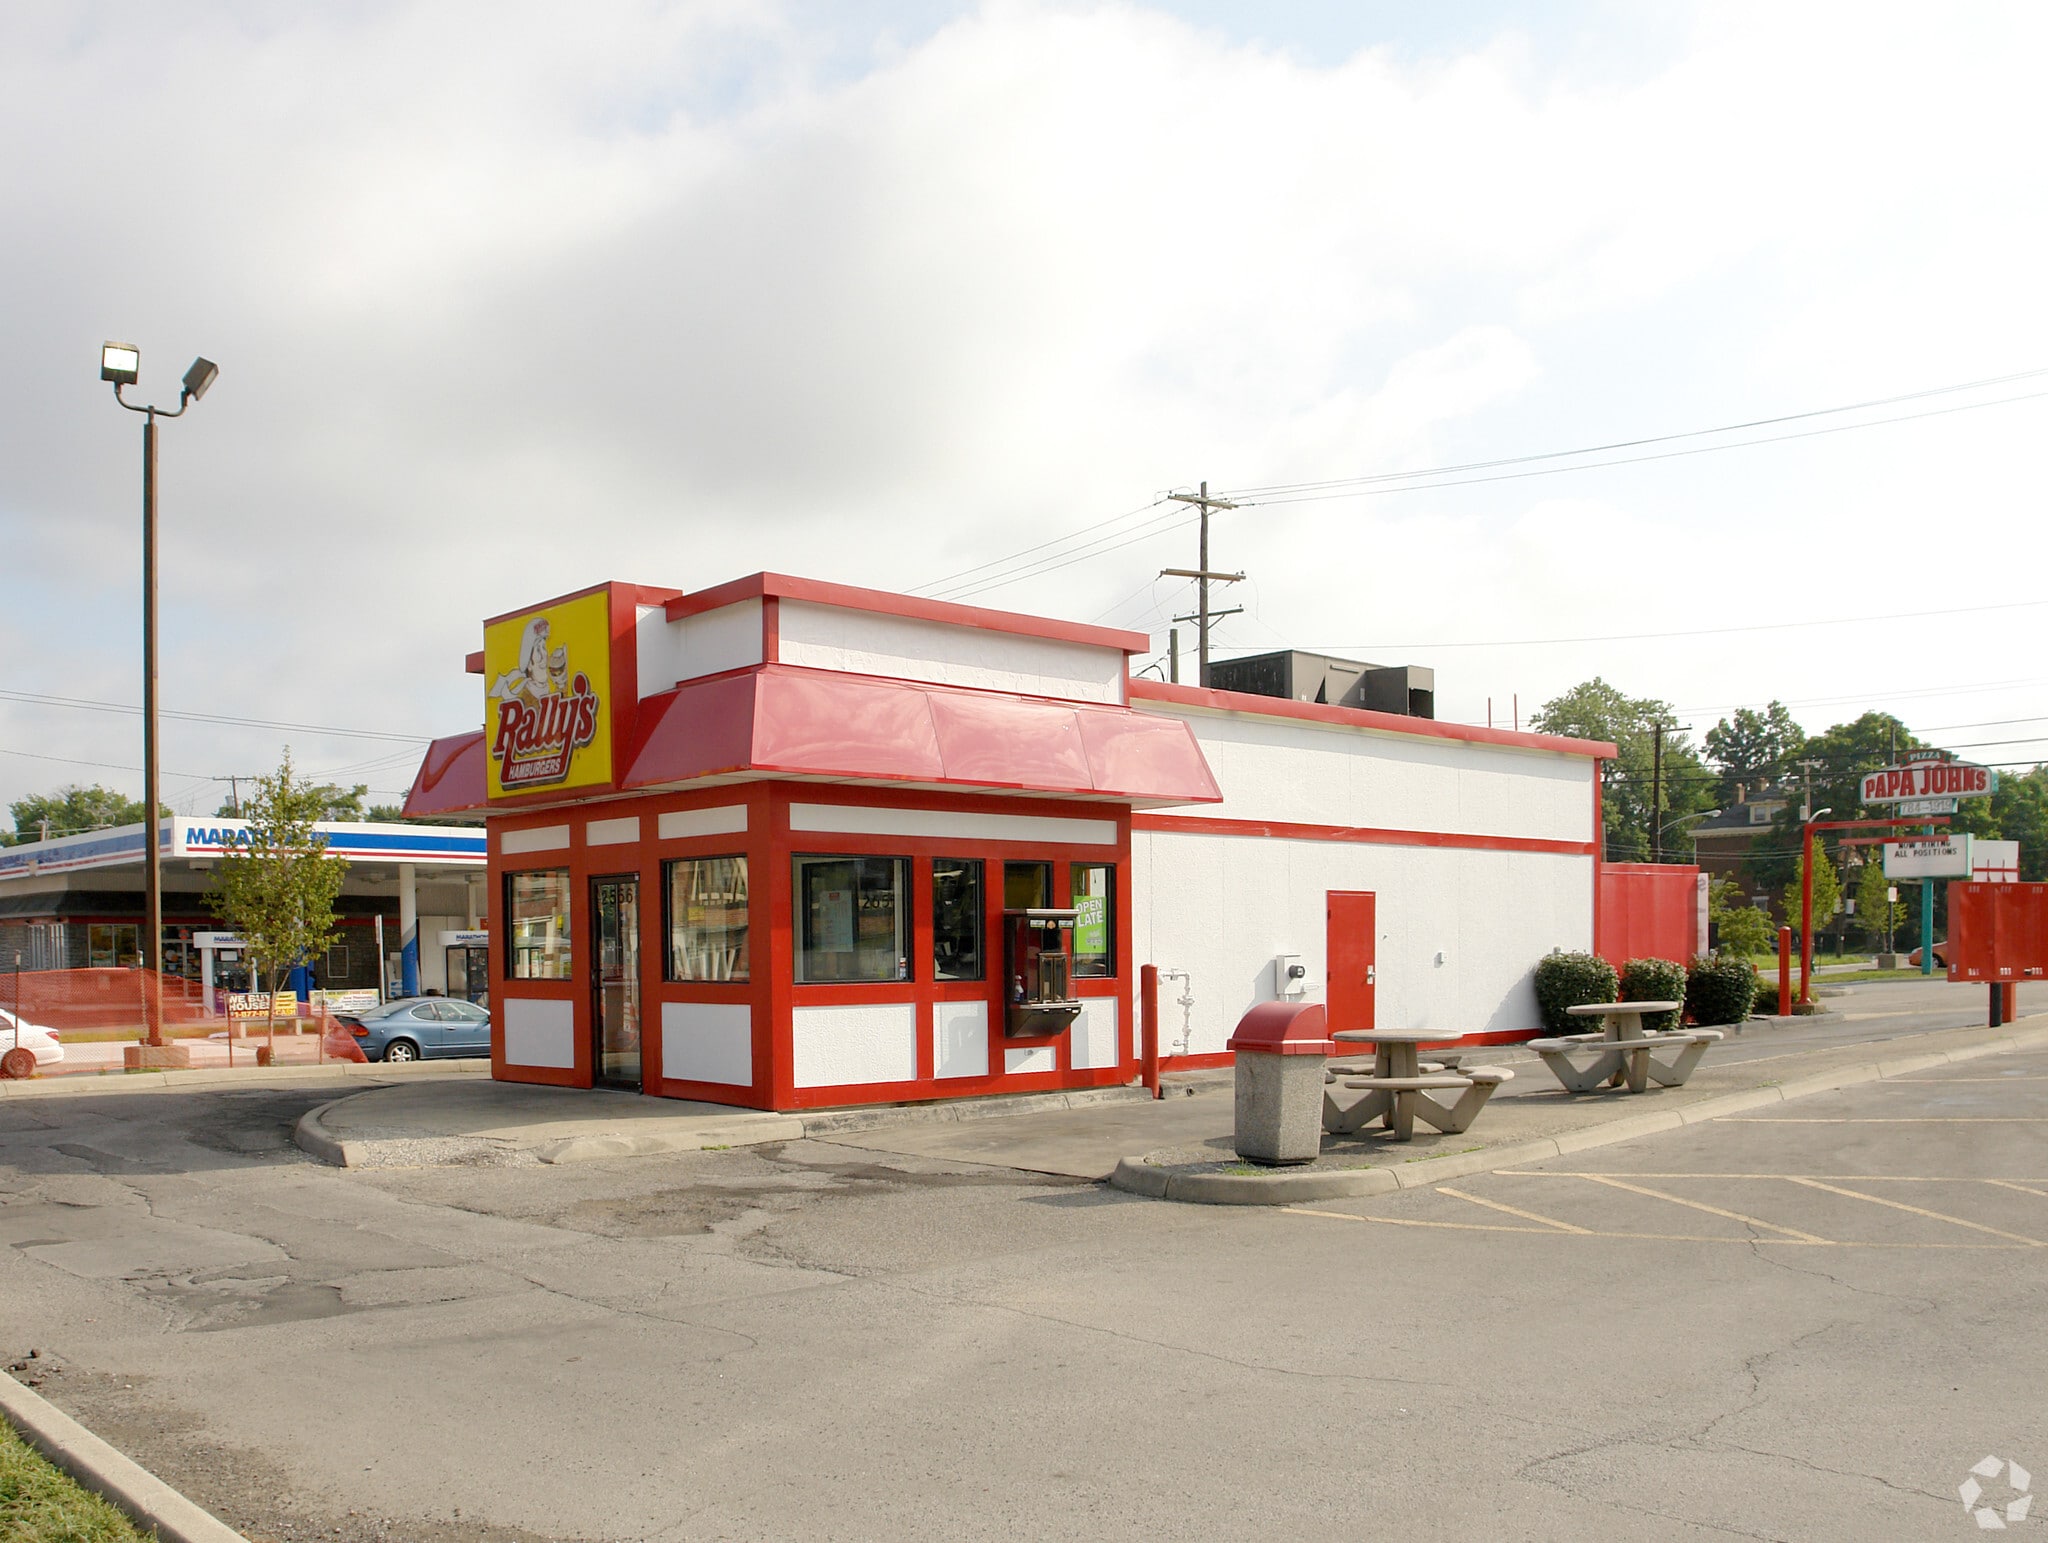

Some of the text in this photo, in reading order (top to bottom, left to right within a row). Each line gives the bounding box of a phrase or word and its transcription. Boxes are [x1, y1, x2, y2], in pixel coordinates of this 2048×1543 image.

[492, 671, 597, 765] Rally's
[1908, 751, 1941, 761] PIZZA
[508, 758, 561, 780] HAMBURGERS
[1865, 767, 1917, 799] PAPA
[186, 827, 308, 847] MARAT
[1894, 848, 1958, 858] ALL POSITIONS
[1075, 898, 1103, 913] OPEN
[1077, 910, 1104, 928] LATE
[248, 994, 271, 1004] BUY
